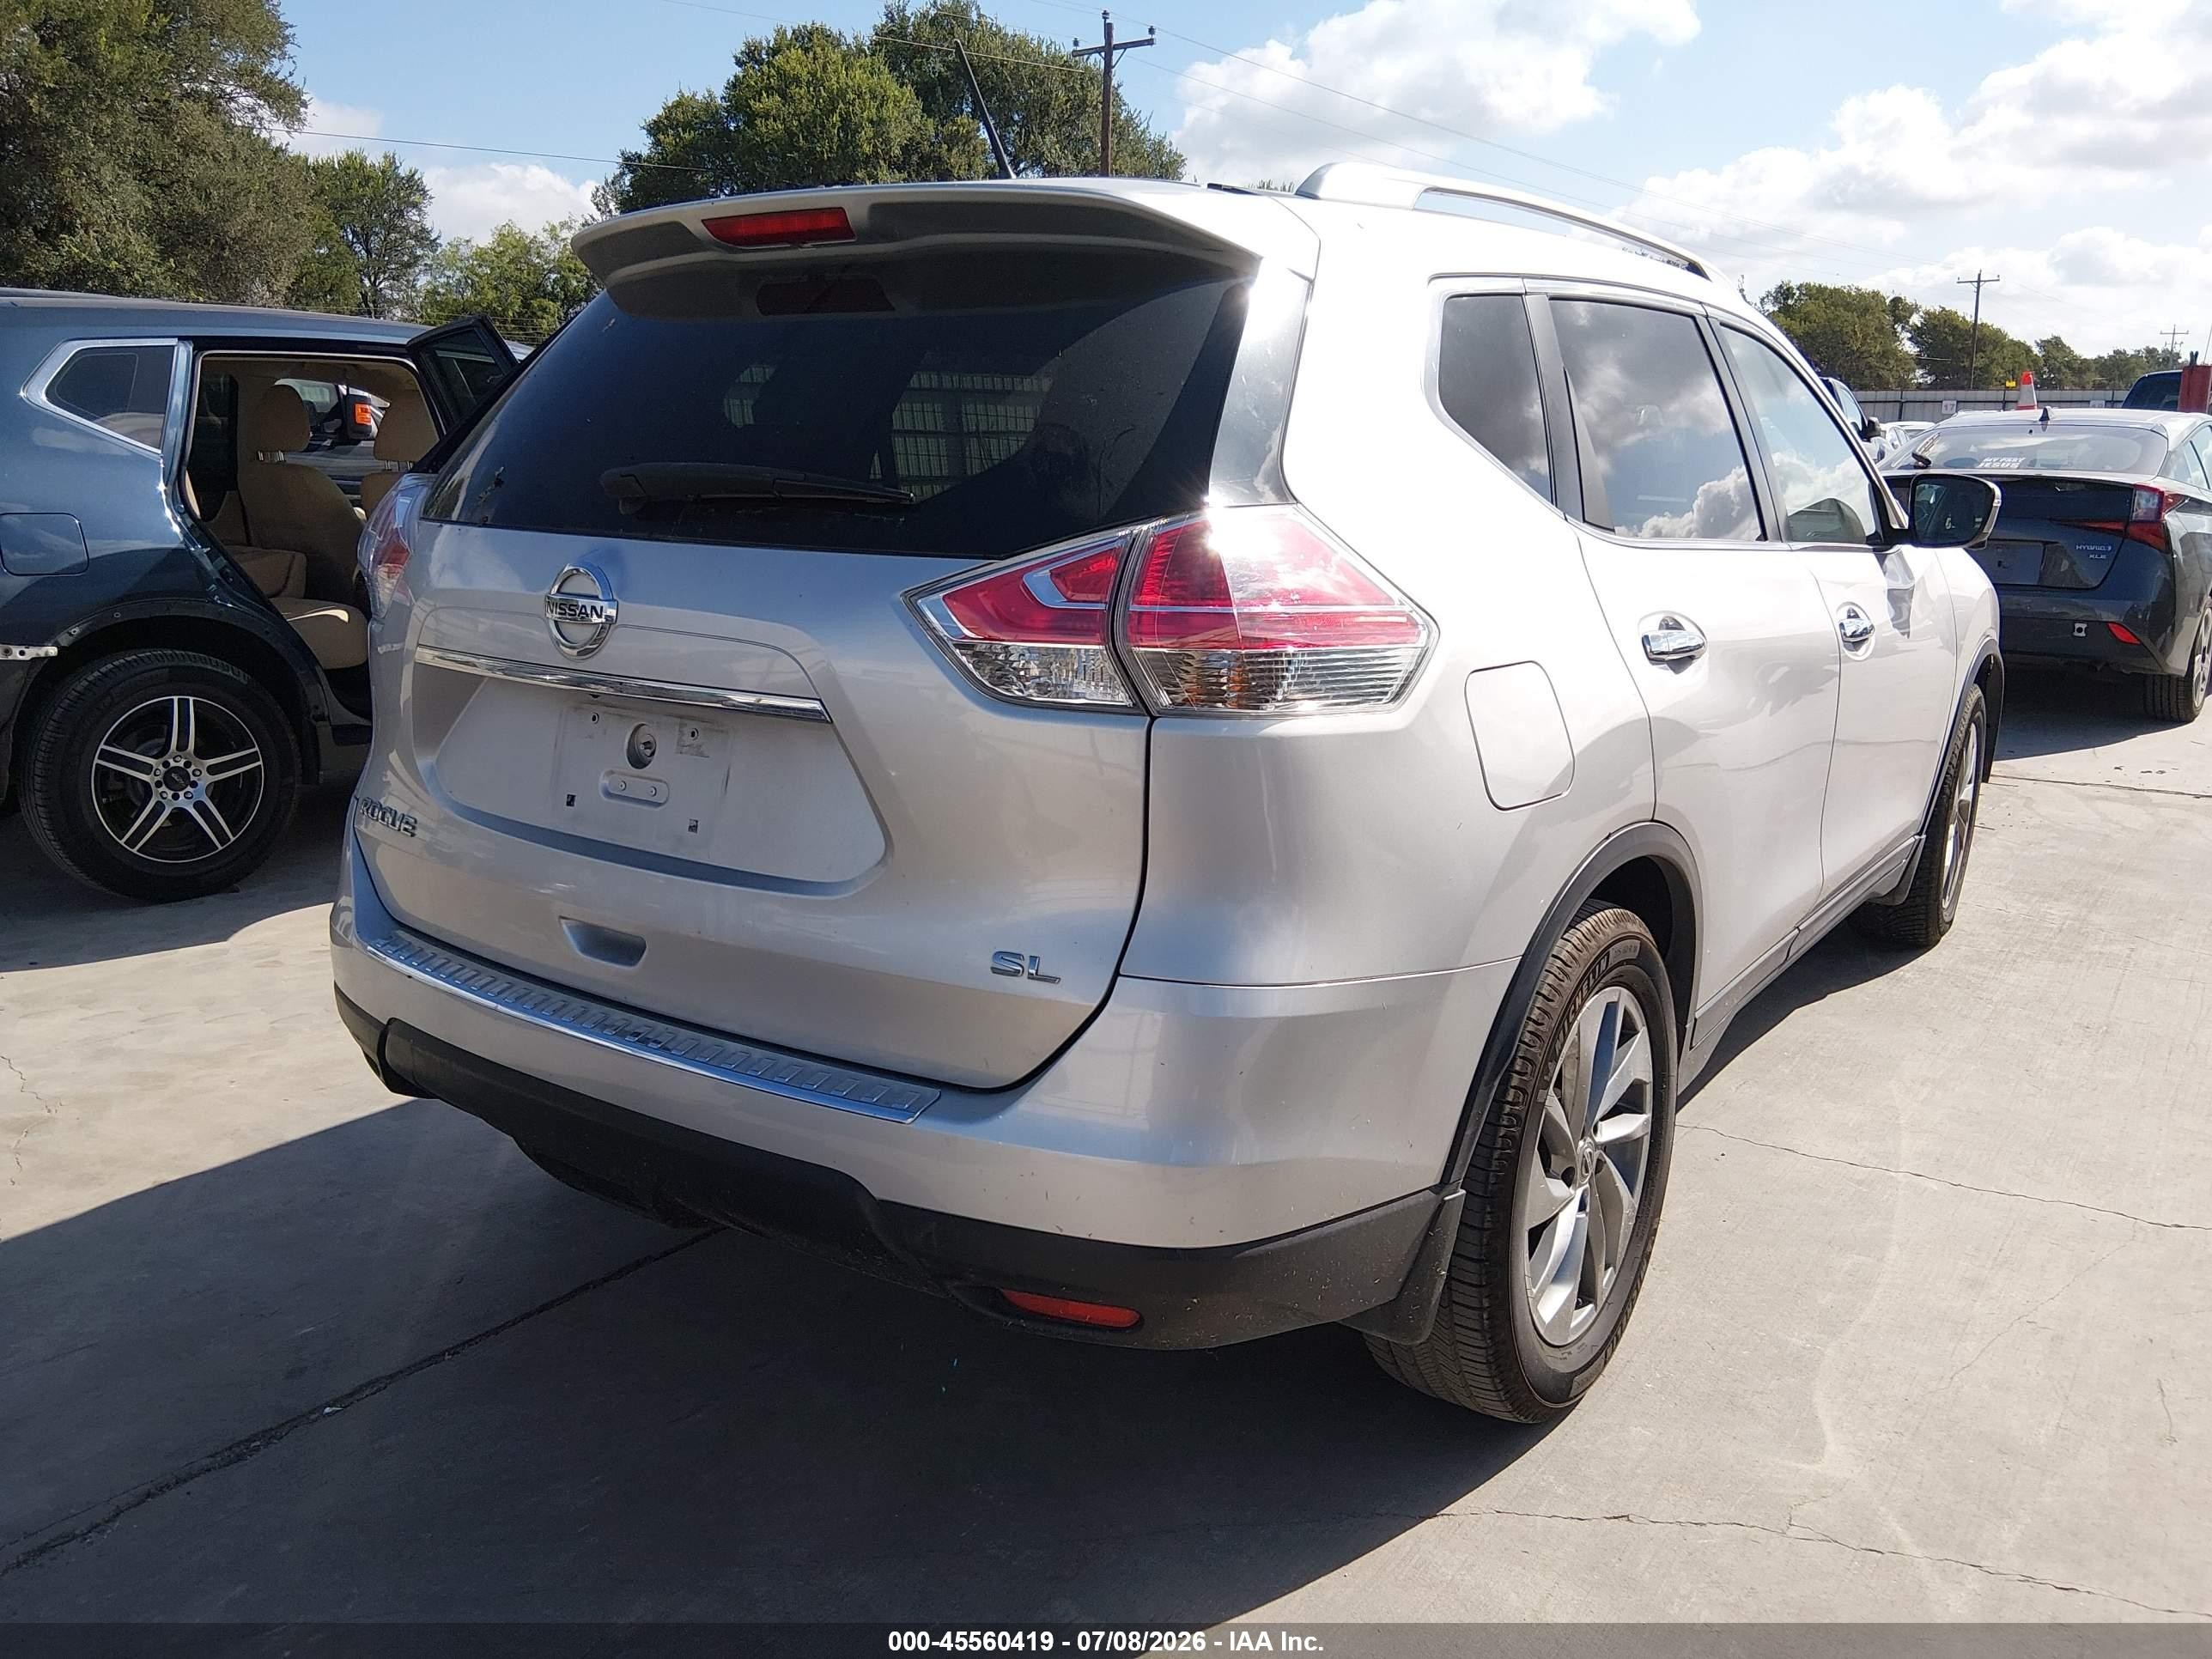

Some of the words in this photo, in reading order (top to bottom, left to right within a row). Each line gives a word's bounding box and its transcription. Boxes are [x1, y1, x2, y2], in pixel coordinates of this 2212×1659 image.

[545, 599, 604, 618] NISSAN
[361, 797, 417, 837] ROGUE
[990, 951, 1061, 984] SL
